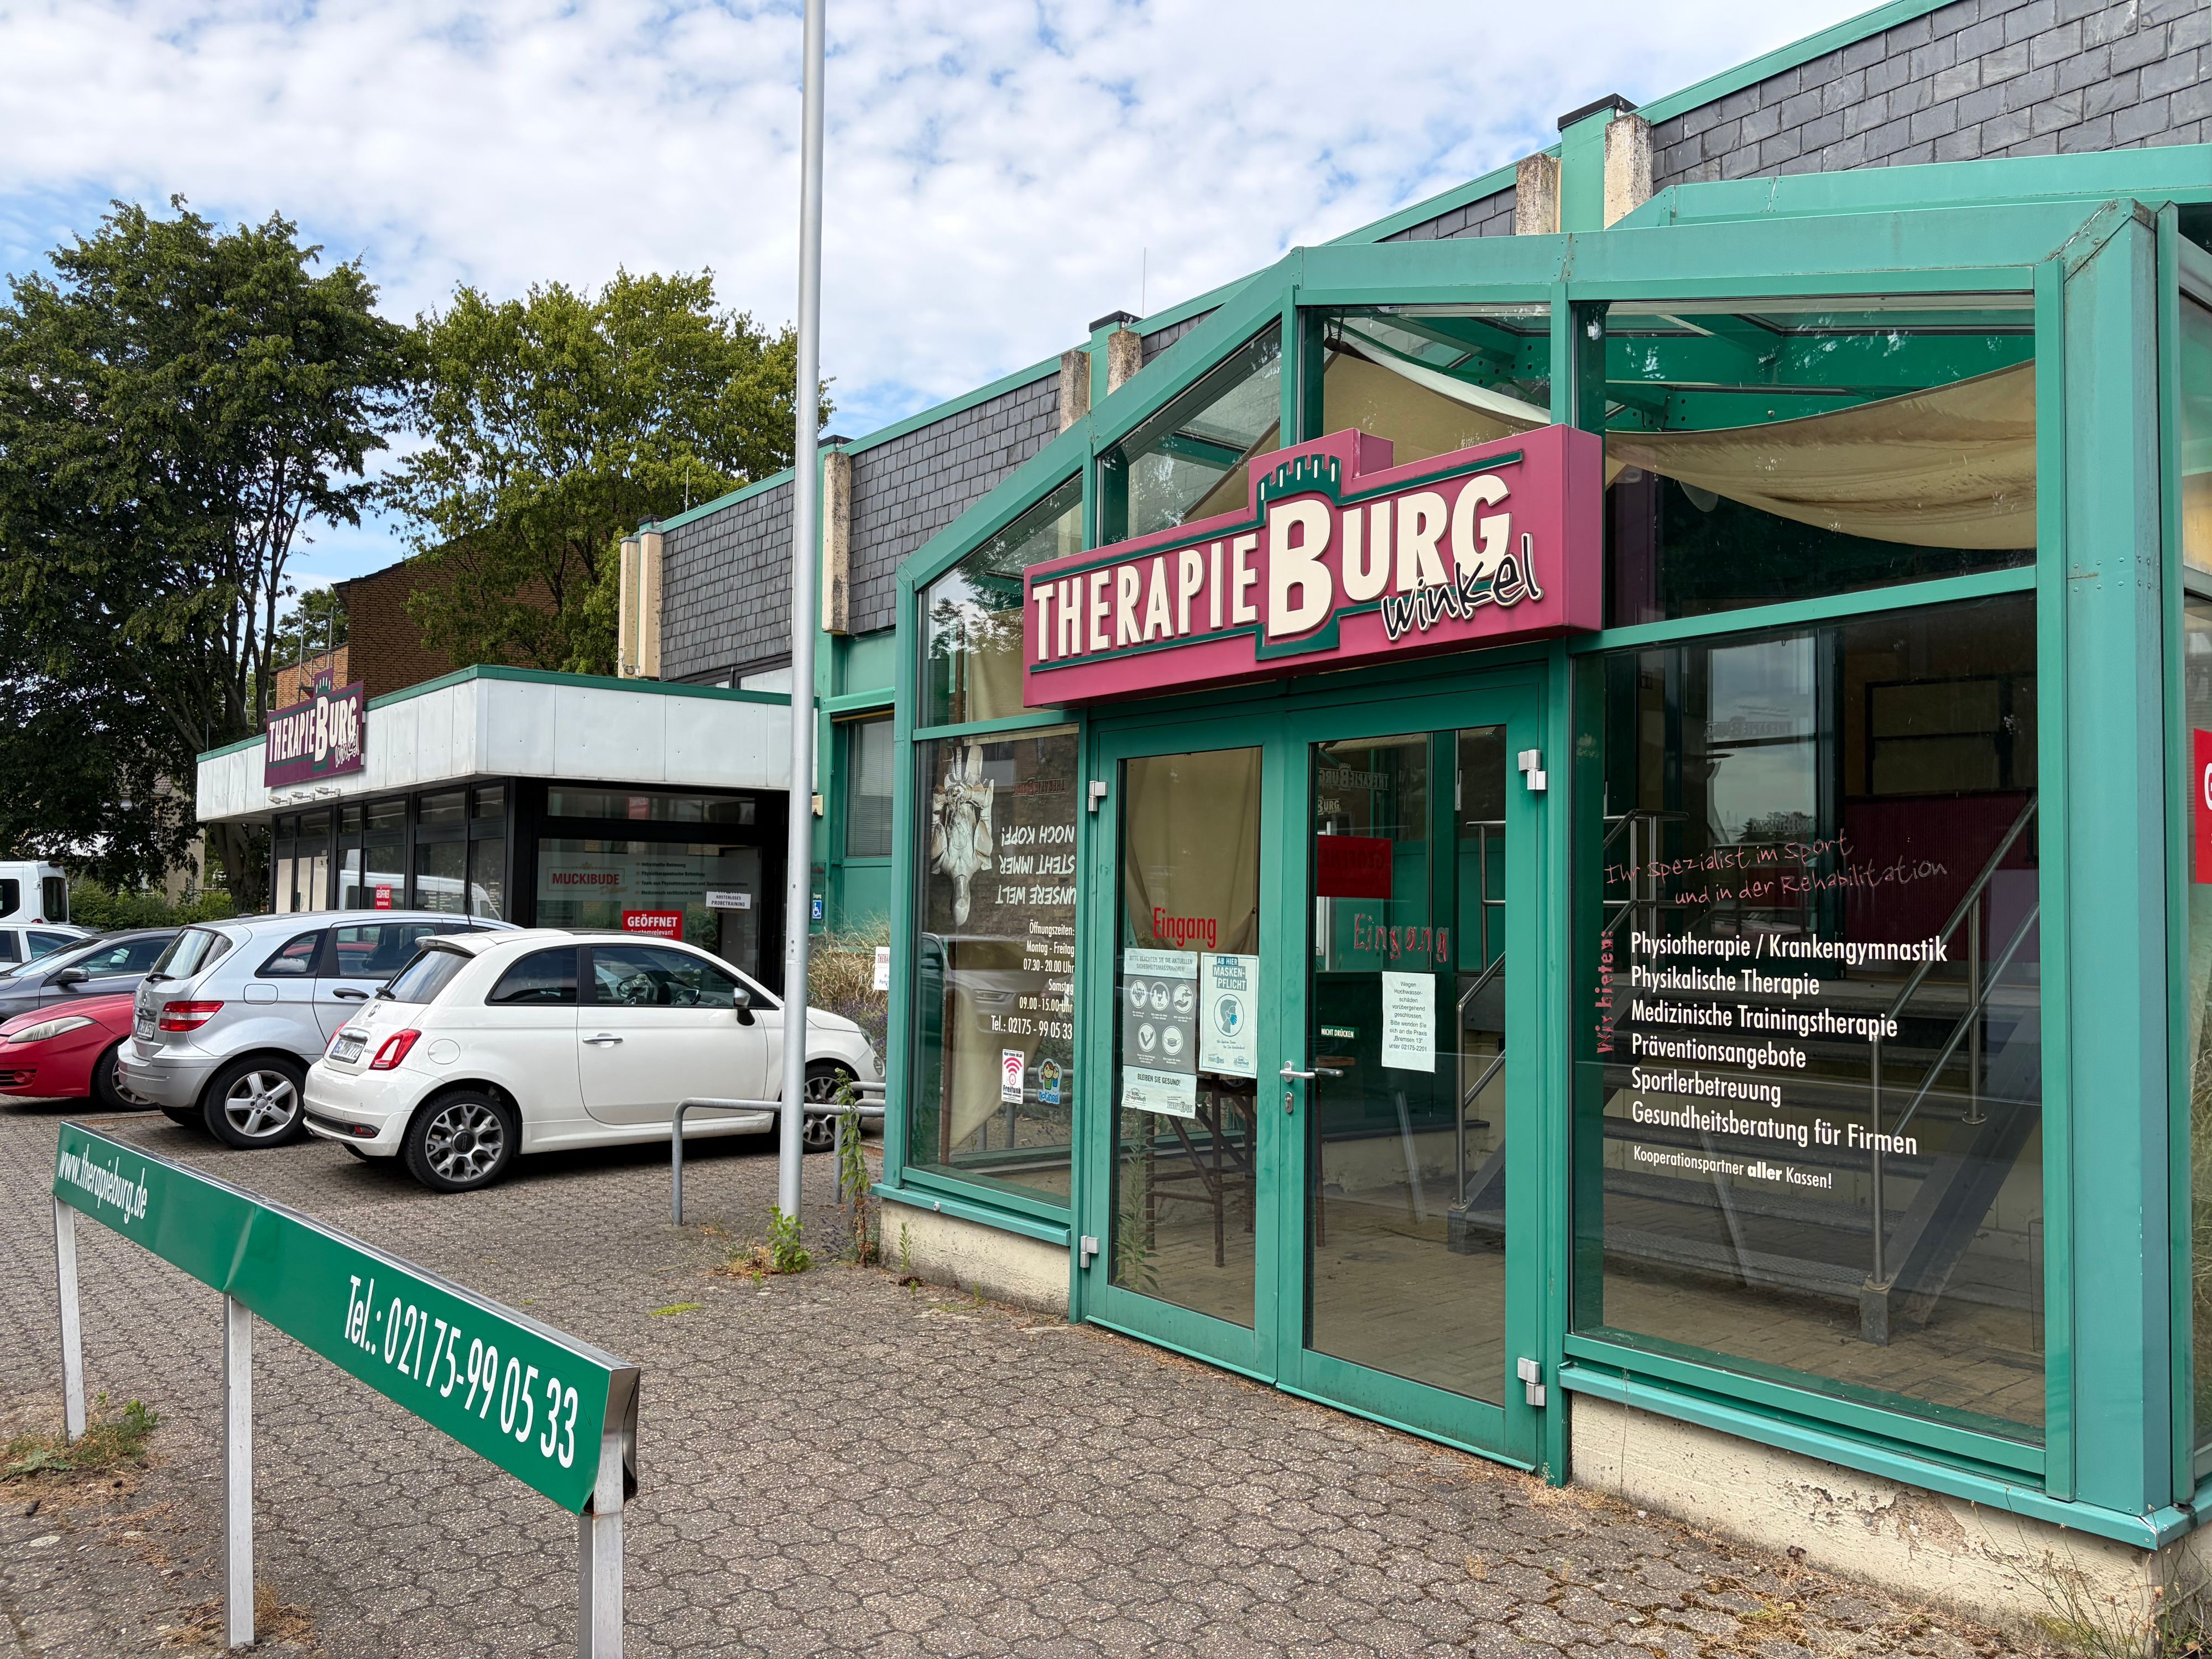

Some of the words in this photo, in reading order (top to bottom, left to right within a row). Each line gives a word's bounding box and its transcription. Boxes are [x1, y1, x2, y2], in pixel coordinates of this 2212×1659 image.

[1001, 826, 1035, 847] KOPF!
[1039, 825, 1074, 843] NOCH
[1000, 855, 1034, 875] IMMER
[1036, 854, 1075, 874] STEHT
[1757, 846, 1777, 864] im
[552, 873, 620, 885] MUCKIBUDE
[995, 885, 1025, 905] WELT
[1030, 884, 1077, 905] UNSERE
[1676, 885, 1711, 904] und
[1717, 884, 1732, 902] in
[1739, 880, 1774, 899] der
[628, 914, 678, 927] GEÖFFNET
[1029, 919, 1075, 937] Öffnungszeiten:
[1153, 907, 1217, 948] Eingang
[1026, 940, 1048, 956] Montag
[1053, 942, 1075, 958] Freitag
[1631, 932, 1750, 961] Physiotherapie
[1769, 935, 1948, 964] Krankengymnastik
[1023, 958, 1040, 971] 07.30
[1045, 960, 1062, 973] 20.00
[1063, 961, 1074, 973] Uhr
[1213, 967, 1245, 977] MASKEN-
[1048, 978, 1074, 995] Samstag
[1218, 978, 1246, 990] PFLICHT
[1631, 966, 1736, 995] Physikalische
[1741, 969, 1819, 999] Therapie
[1019, 997, 1037, 1010] 09.00
[1061, 999, 1073, 1013] Uhr
[1392, 1004, 1426, 1012] vorübergehend
[991, 1015, 1006, 1032] Tel.:
[1008, 1018, 1031, 1035] 02175
[1039, 1022, 1048, 1037] 99
[1051, 1024, 1060, 1039] 05
[1062, 1023, 1073, 1040] 33
[1631, 1000, 1733, 1026] Medizinische
[1737, 1005, 1898, 1041] Trainingstherapie
[1321, 1027, 1333, 1036] NICHT
[1334, 1028, 1354, 1038] DRÜCKEN
[1632, 1034, 1807, 1071] Präventionsangebote
[1138, 1073, 1154, 1082] BLEIBEN
[1162, 1077, 1181, 1086] GESUND!
[1632, 1067, 1782, 1108] Sportlerbetreuung
[1632, 1101, 1808, 1147] Gesundheitsberatung
[1814, 1118, 1840, 1146] für
[1847, 1123, 1917, 1155] Firmen
[1634, 1145, 1744, 1179] Kooperationspartner
[1747, 1161, 1782, 1181] aller
[1786, 1167, 1832, 1190] Kassen!
[58, 1143, 148, 1224] www.therapieburg.de
[345, 1275, 382, 1355] Tel.:
[500, 1357, 539, 1442] 05
[540, 1378, 578, 1468] 33
